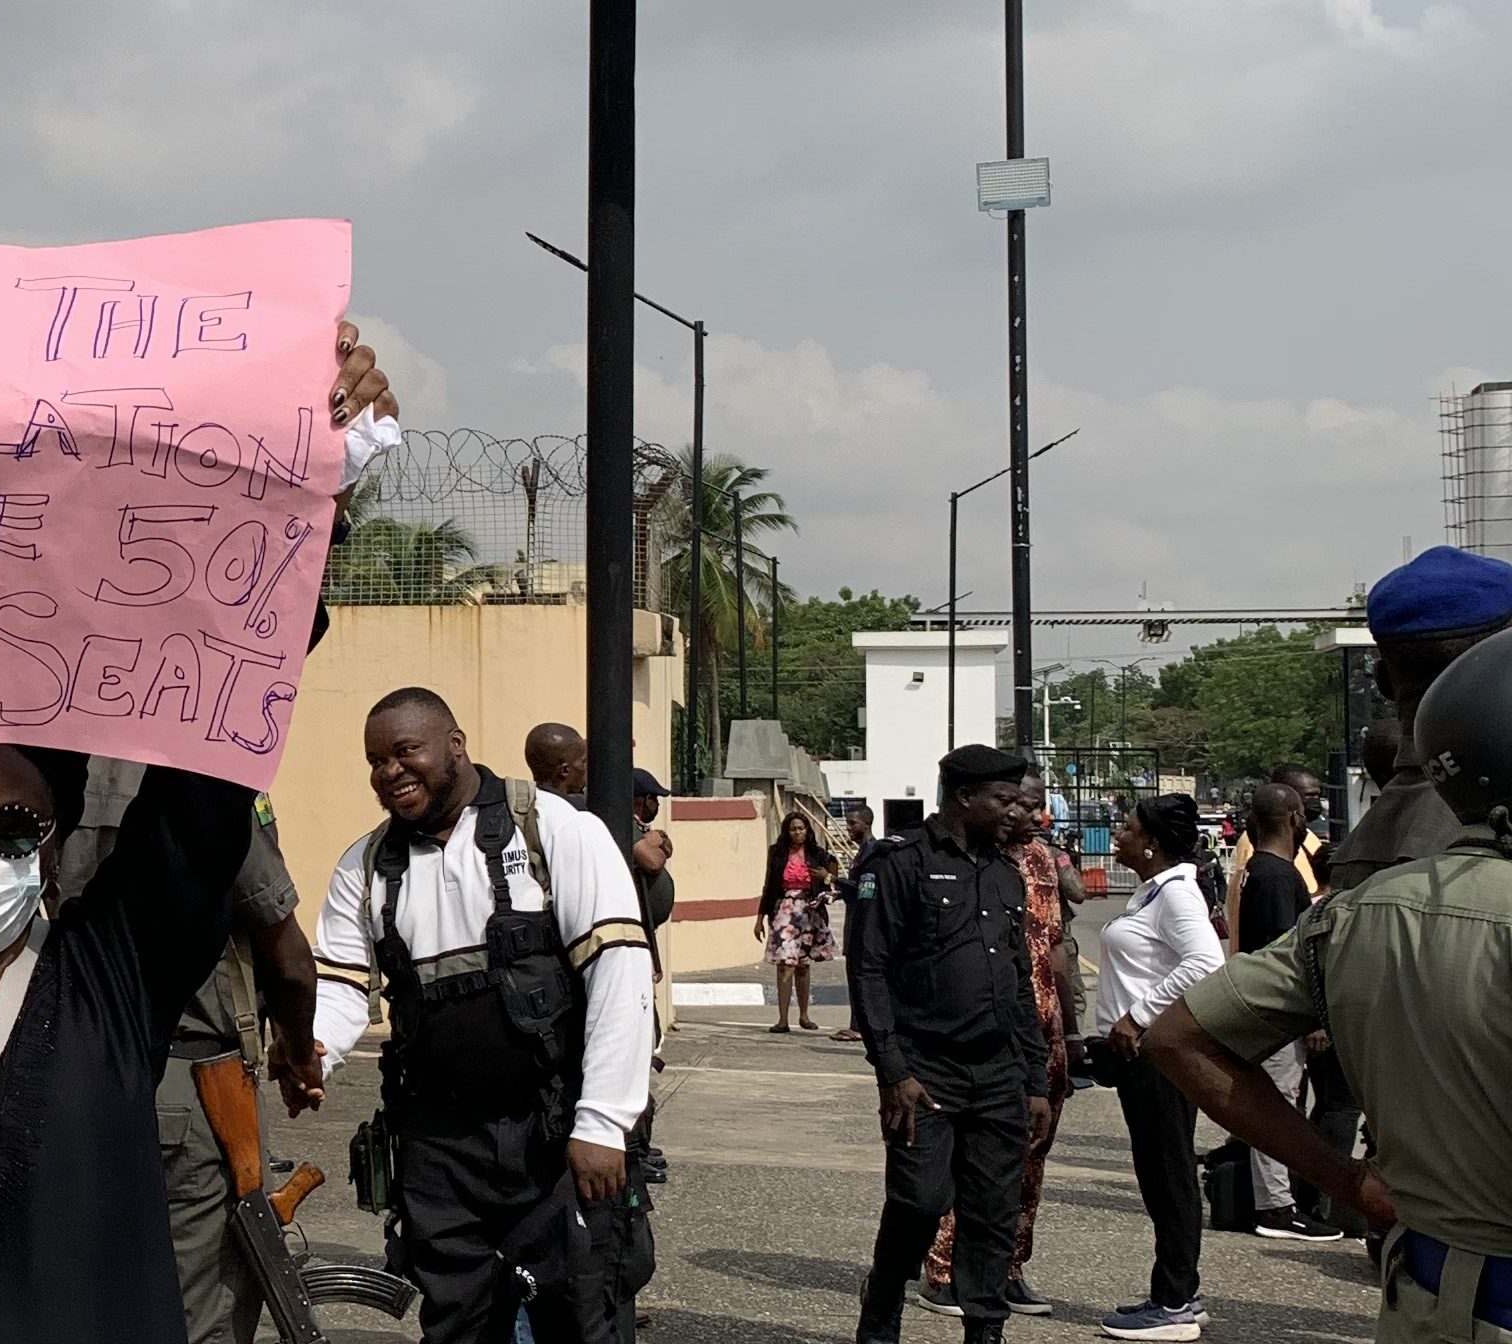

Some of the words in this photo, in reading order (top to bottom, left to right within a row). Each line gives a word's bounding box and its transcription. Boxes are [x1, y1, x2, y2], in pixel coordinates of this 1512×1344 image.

[16, 276, 252, 361] THE
[84, 504, 314, 639] 50%
[503, 849, 528, 863] IMUS
[504, 862, 526, 876] URITY
